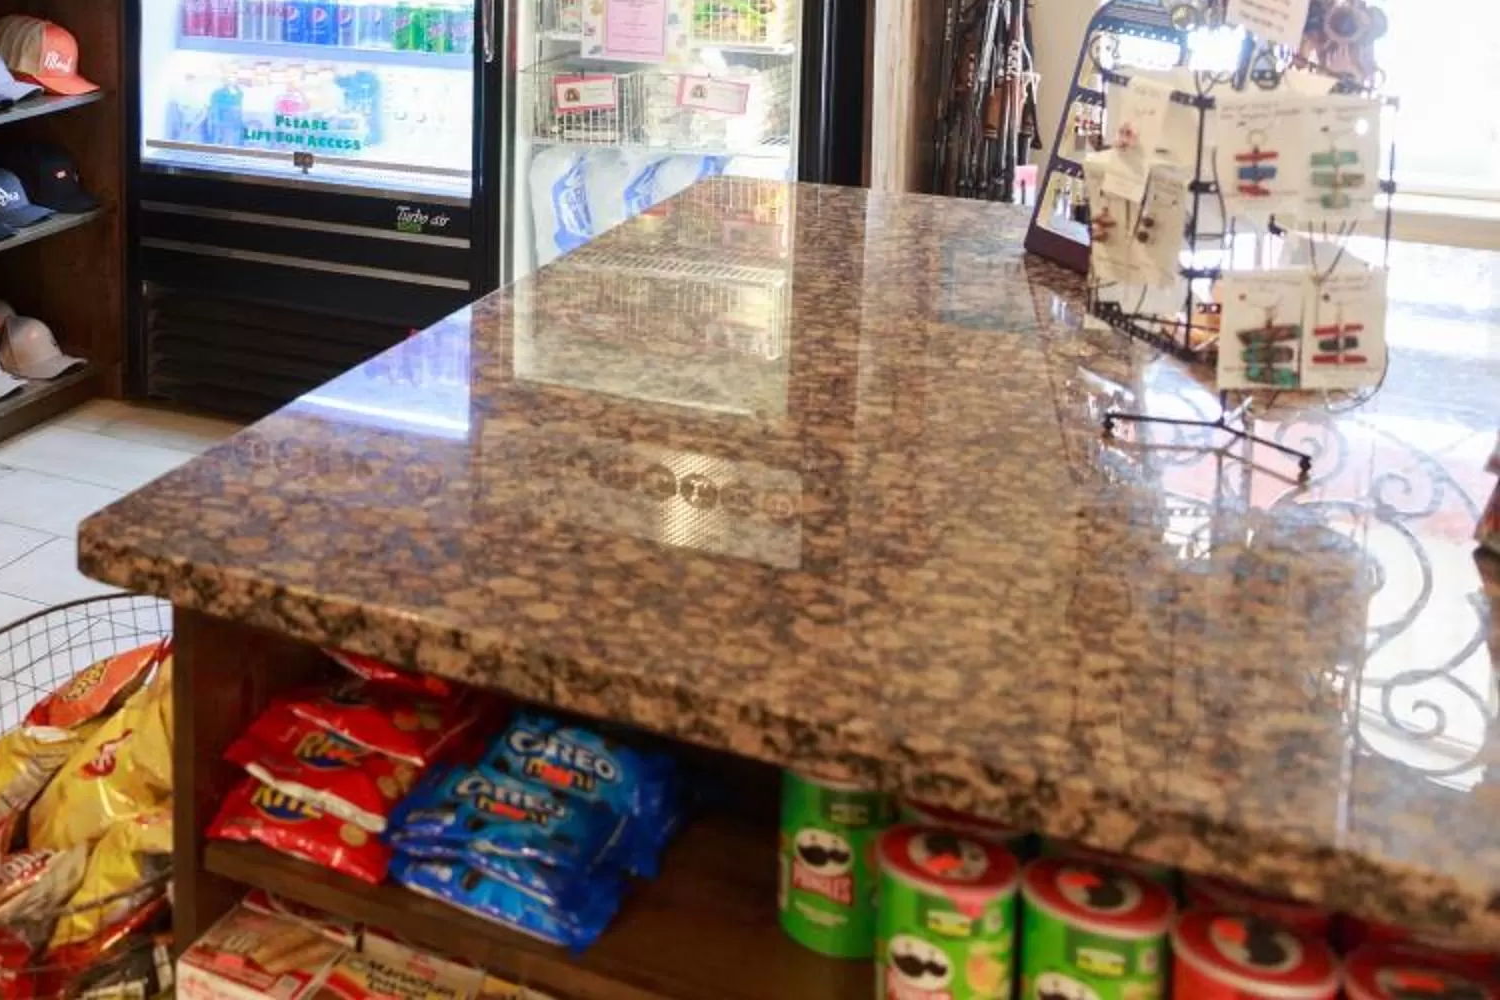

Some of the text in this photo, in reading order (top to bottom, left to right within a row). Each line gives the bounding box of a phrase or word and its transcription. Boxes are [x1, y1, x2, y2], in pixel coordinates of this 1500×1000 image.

[275, 113, 329, 131] PLEASE
[243, 127, 361, 151] LIFT FOR ACCESS
[509, 731, 615, 780] OREO
